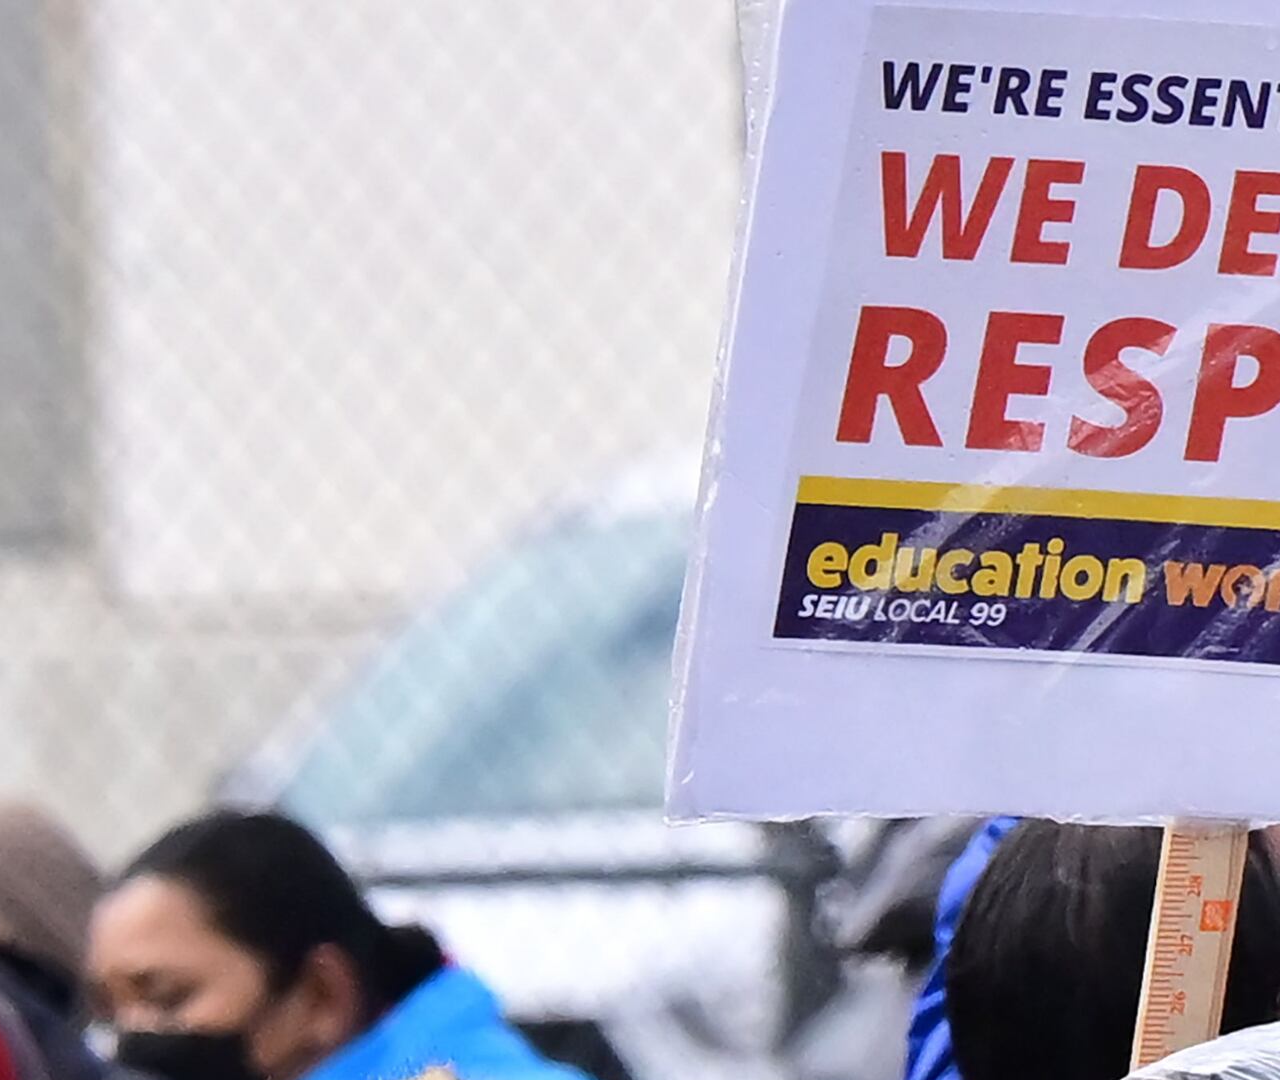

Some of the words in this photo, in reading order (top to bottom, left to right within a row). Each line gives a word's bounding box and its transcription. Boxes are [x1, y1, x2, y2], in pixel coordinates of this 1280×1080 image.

[881, 60, 1069, 118] WE'RE
[880, 150, 1087, 265] WE
[806, 532, 1147, 606] education
[798, 593, 871, 620] SEIU
[874, 595, 960, 625] LOCAL
[969, 601, 1007, 627] 99
